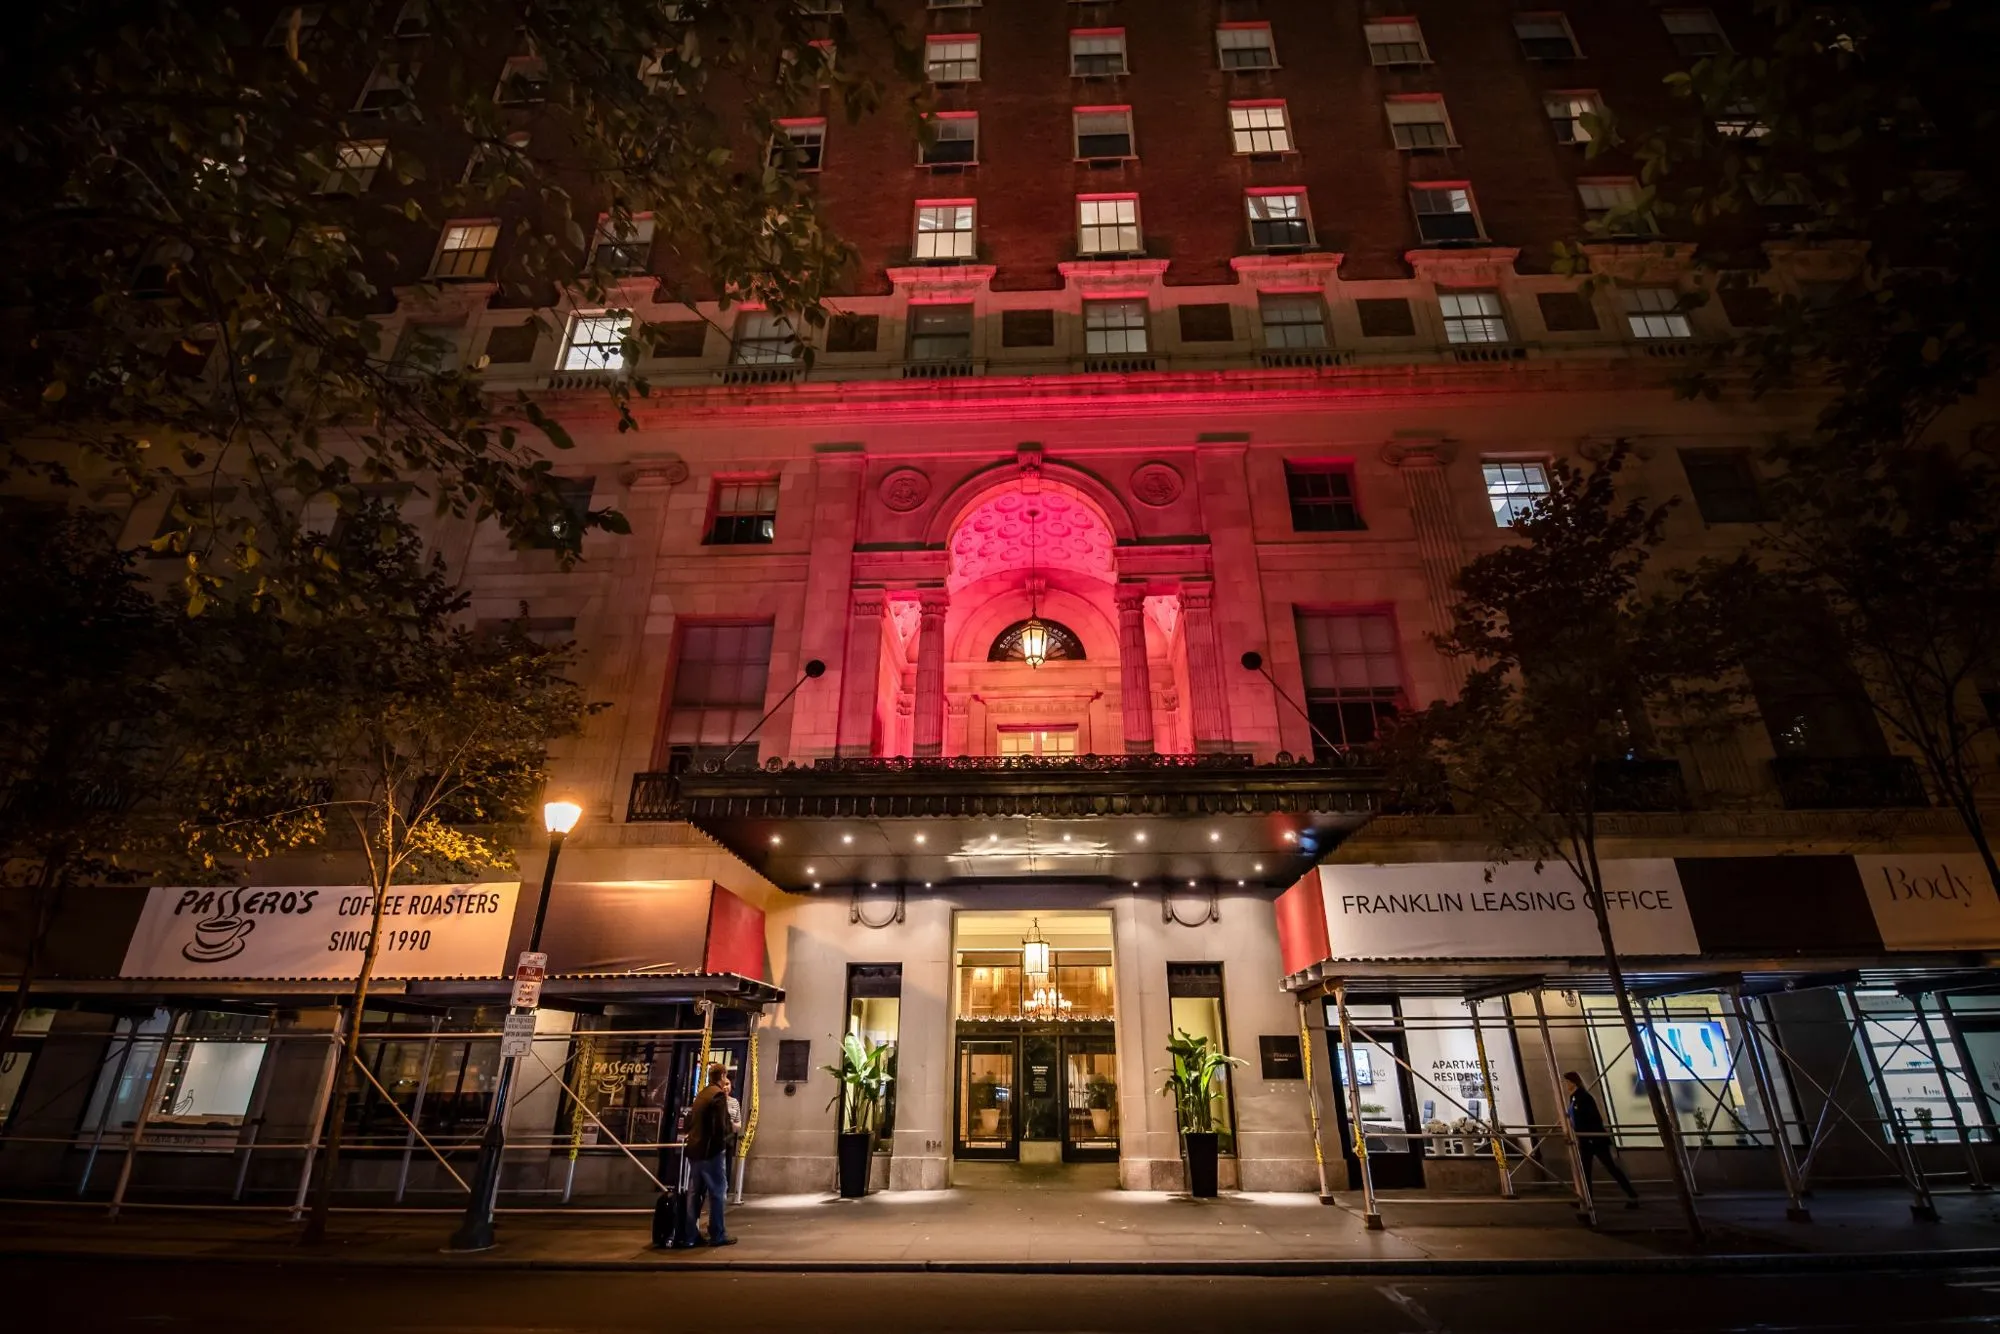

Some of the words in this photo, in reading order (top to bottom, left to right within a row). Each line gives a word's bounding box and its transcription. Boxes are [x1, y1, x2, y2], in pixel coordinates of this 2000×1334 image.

[1882, 864, 1972, 907] Body
[175, 887, 319, 920] PASSERO'S
[408, 893, 499, 915] ROASTERS
[1342, 892, 1464, 914] FRANKLIN
[1470, 891, 1576, 912] LEASING
[328, 930, 382, 951] SINC
[388, 930, 431, 951] 1990
[592, 1060, 651, 1075] PASSERO'S
[1432, 1060, 1495, 1069] APARTMET
[1434, 1071, 1499, 1082] RESIDENCS
